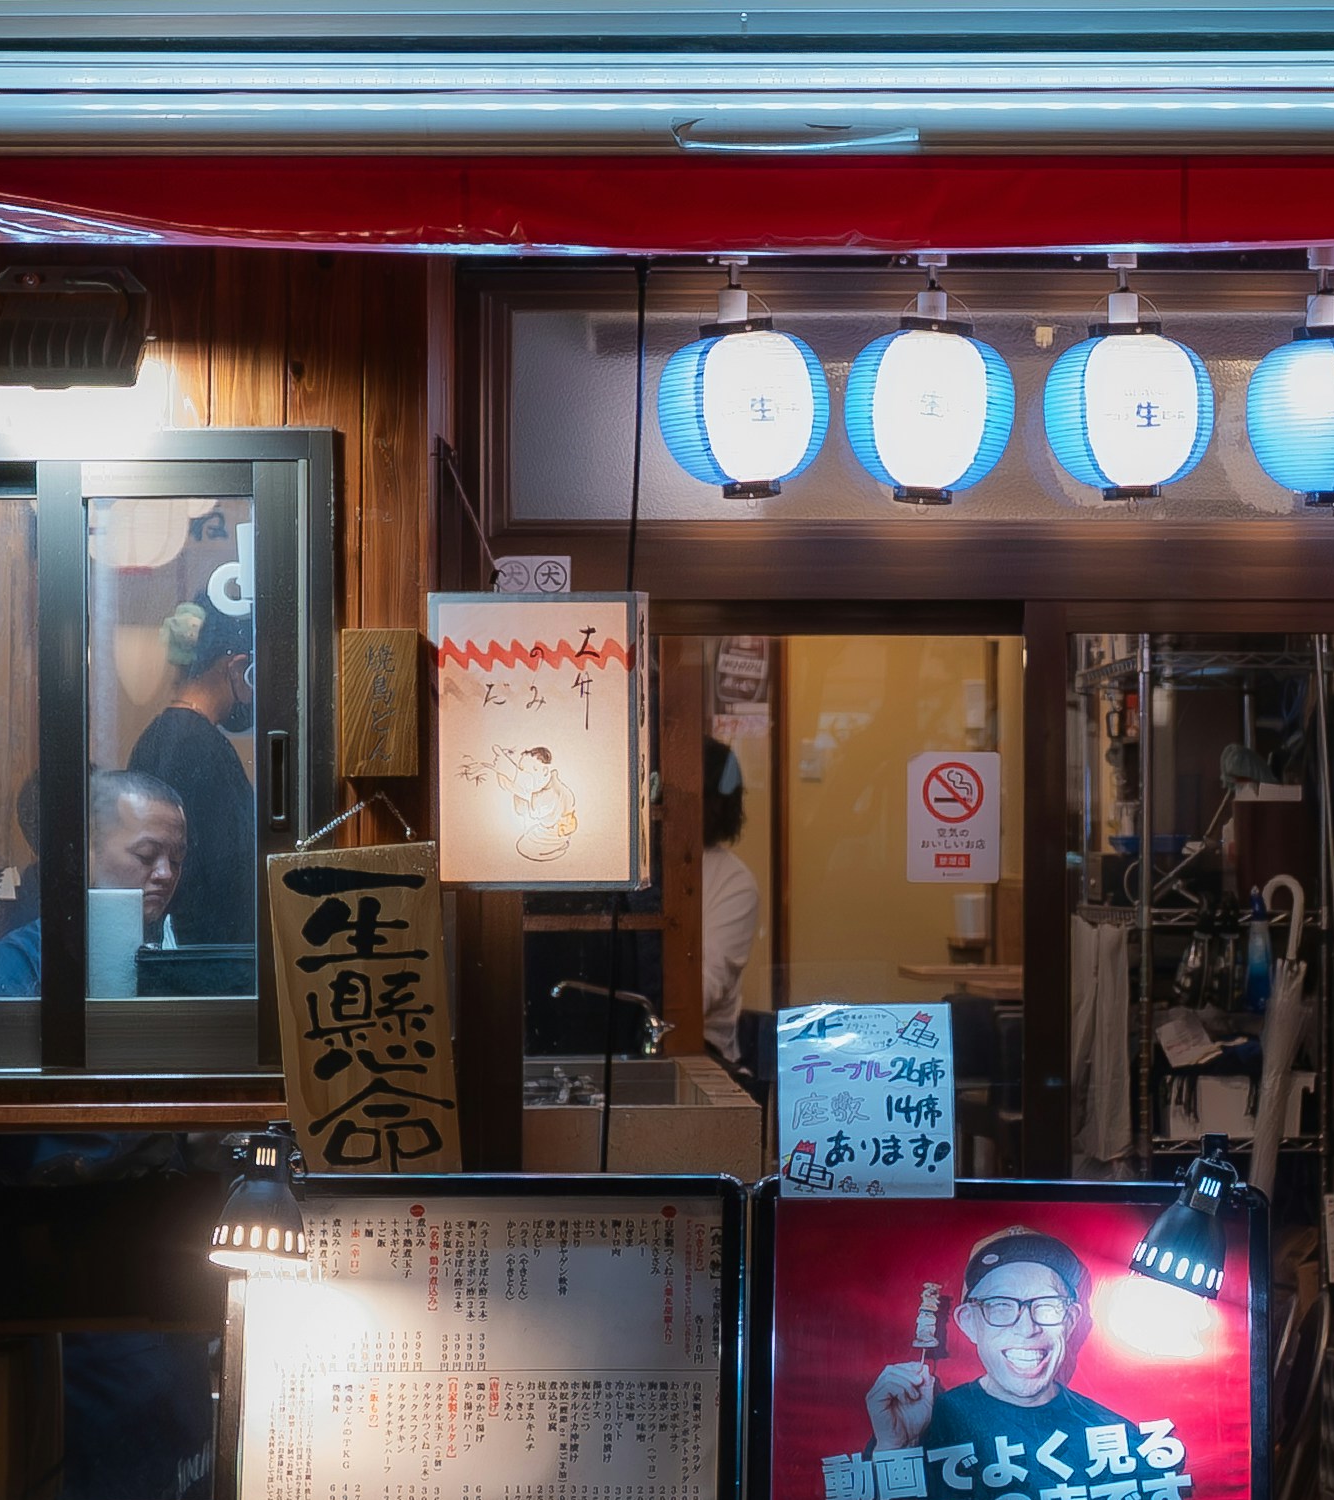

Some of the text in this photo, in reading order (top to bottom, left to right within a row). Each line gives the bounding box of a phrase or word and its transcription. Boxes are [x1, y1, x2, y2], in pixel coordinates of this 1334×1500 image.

[920, 839, 986, 849] おいしいお店
[282, 866, 455, 1172] 一生懸命
[504, 1382, 513, 1421] たくあん
